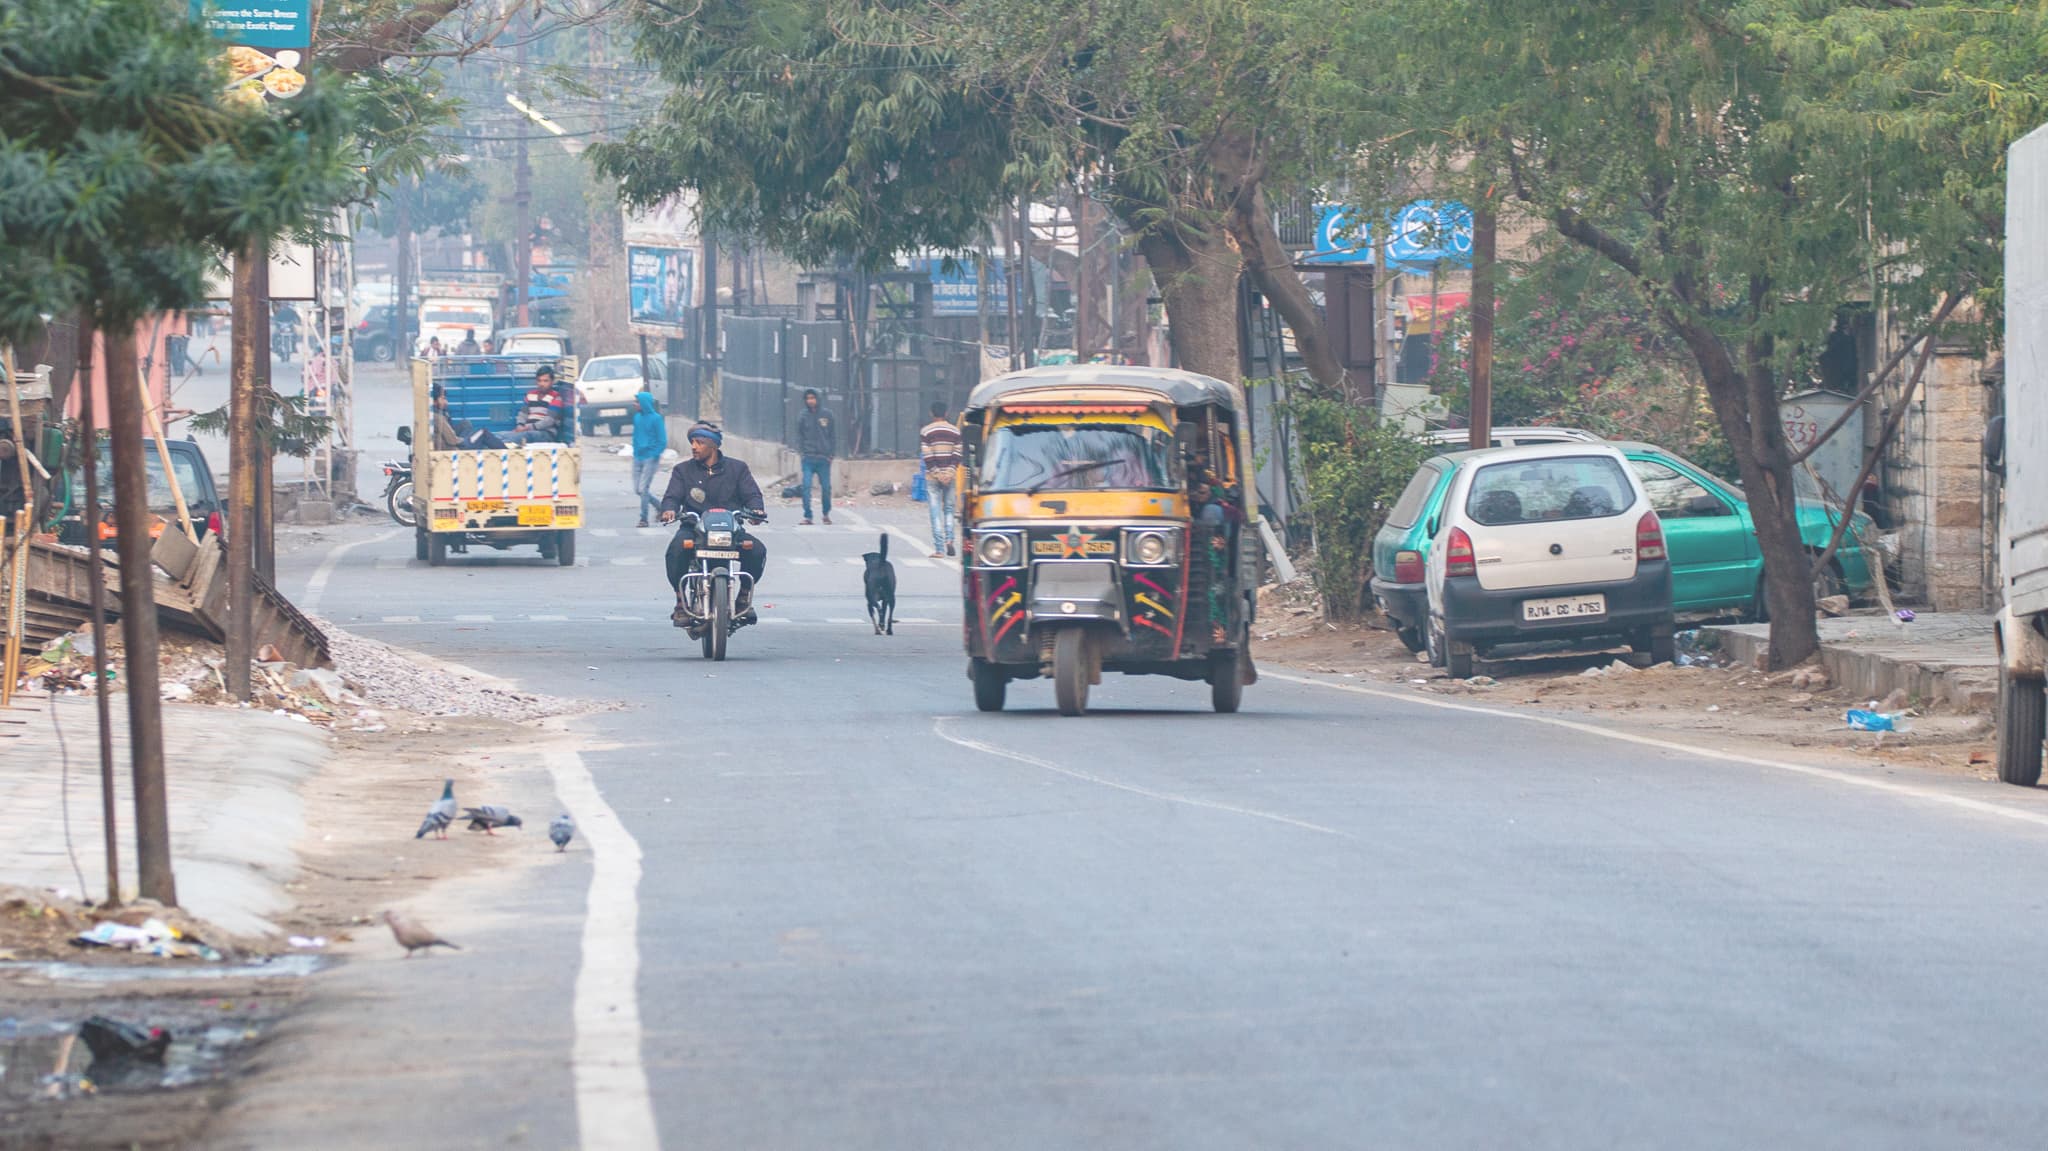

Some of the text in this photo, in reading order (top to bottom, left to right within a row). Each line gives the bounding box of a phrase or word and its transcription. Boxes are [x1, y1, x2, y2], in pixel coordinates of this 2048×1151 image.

[202, 8, 239, 18] Eerience
[240, 9, 252, 17] the
[246, 21, 268, 30] Exotic
